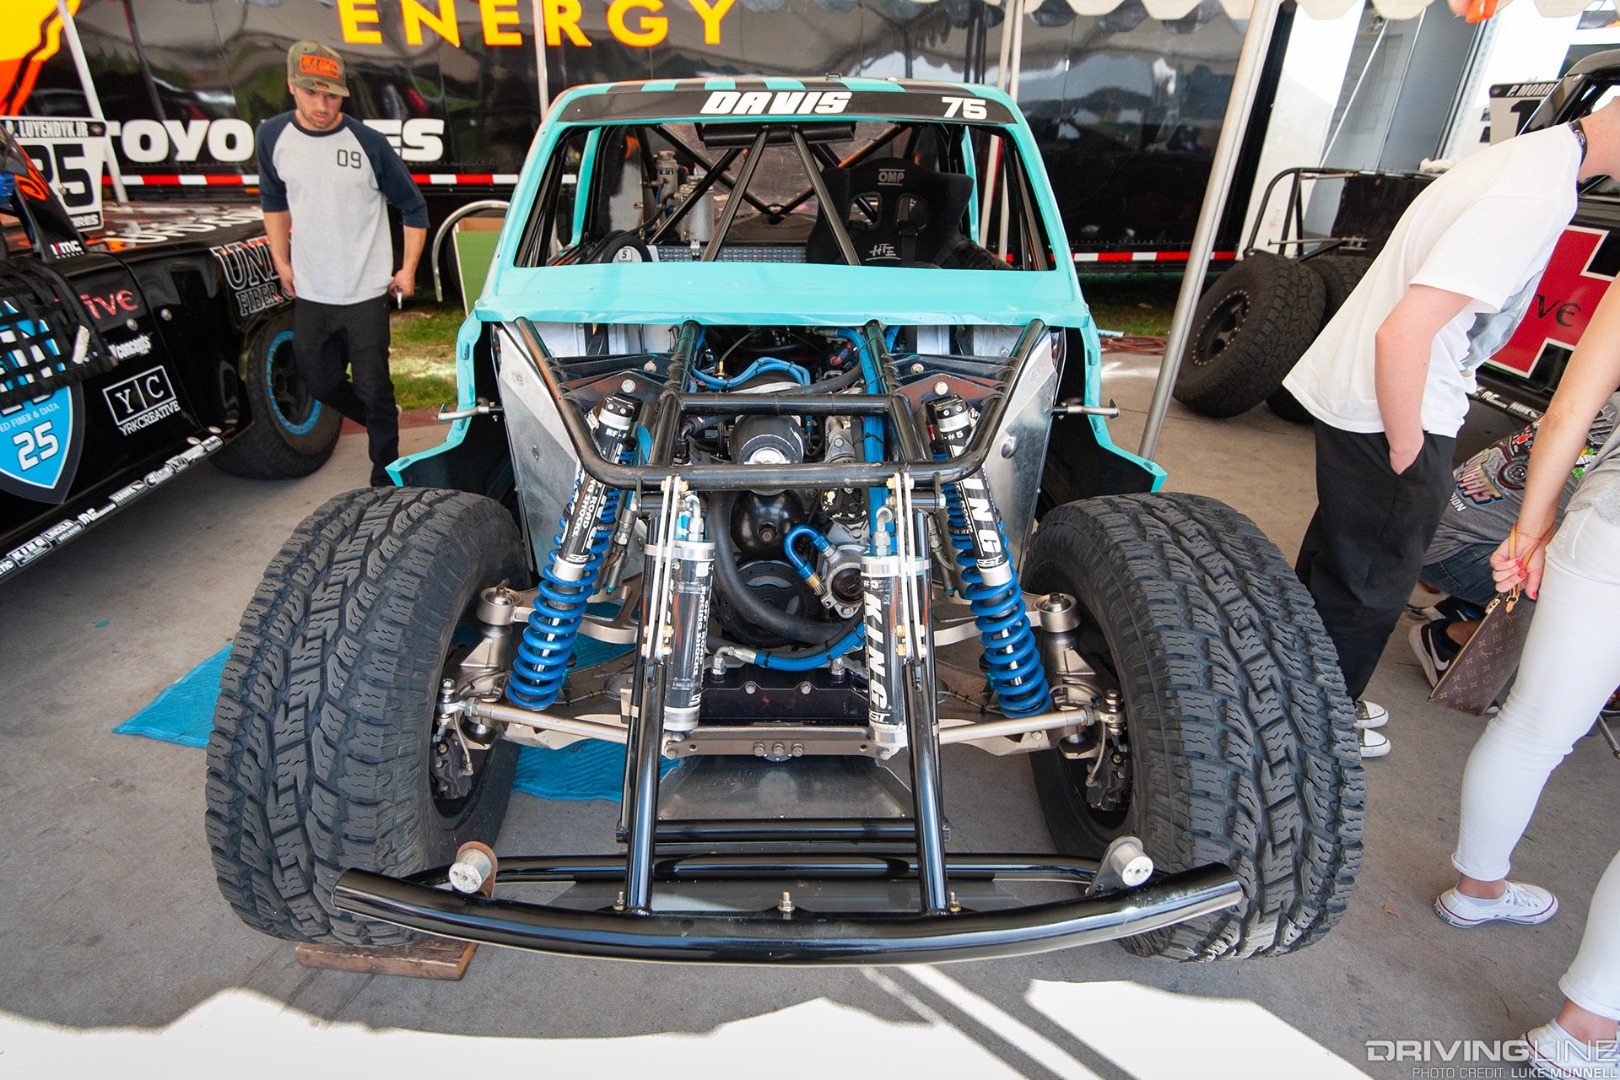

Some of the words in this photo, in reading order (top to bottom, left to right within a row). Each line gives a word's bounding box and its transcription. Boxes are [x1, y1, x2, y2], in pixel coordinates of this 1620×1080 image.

[335, 0, 735, 48] ENERGY
[700, 91, 852, 114] DAVIS
[941, 96, 987, 119] 75
[20, 120, 76, 138] LUYENDYK
[337, 149, 362, 169] 09
[879, 172, 905, 183] OMP
[209, 236, 280, 290] UNI
[39, 402, 60, 416] DATA
[12, 420, 60, 472] 25
[11, 538, 47, 560] KING
[864, 591, 888, 709] KING
